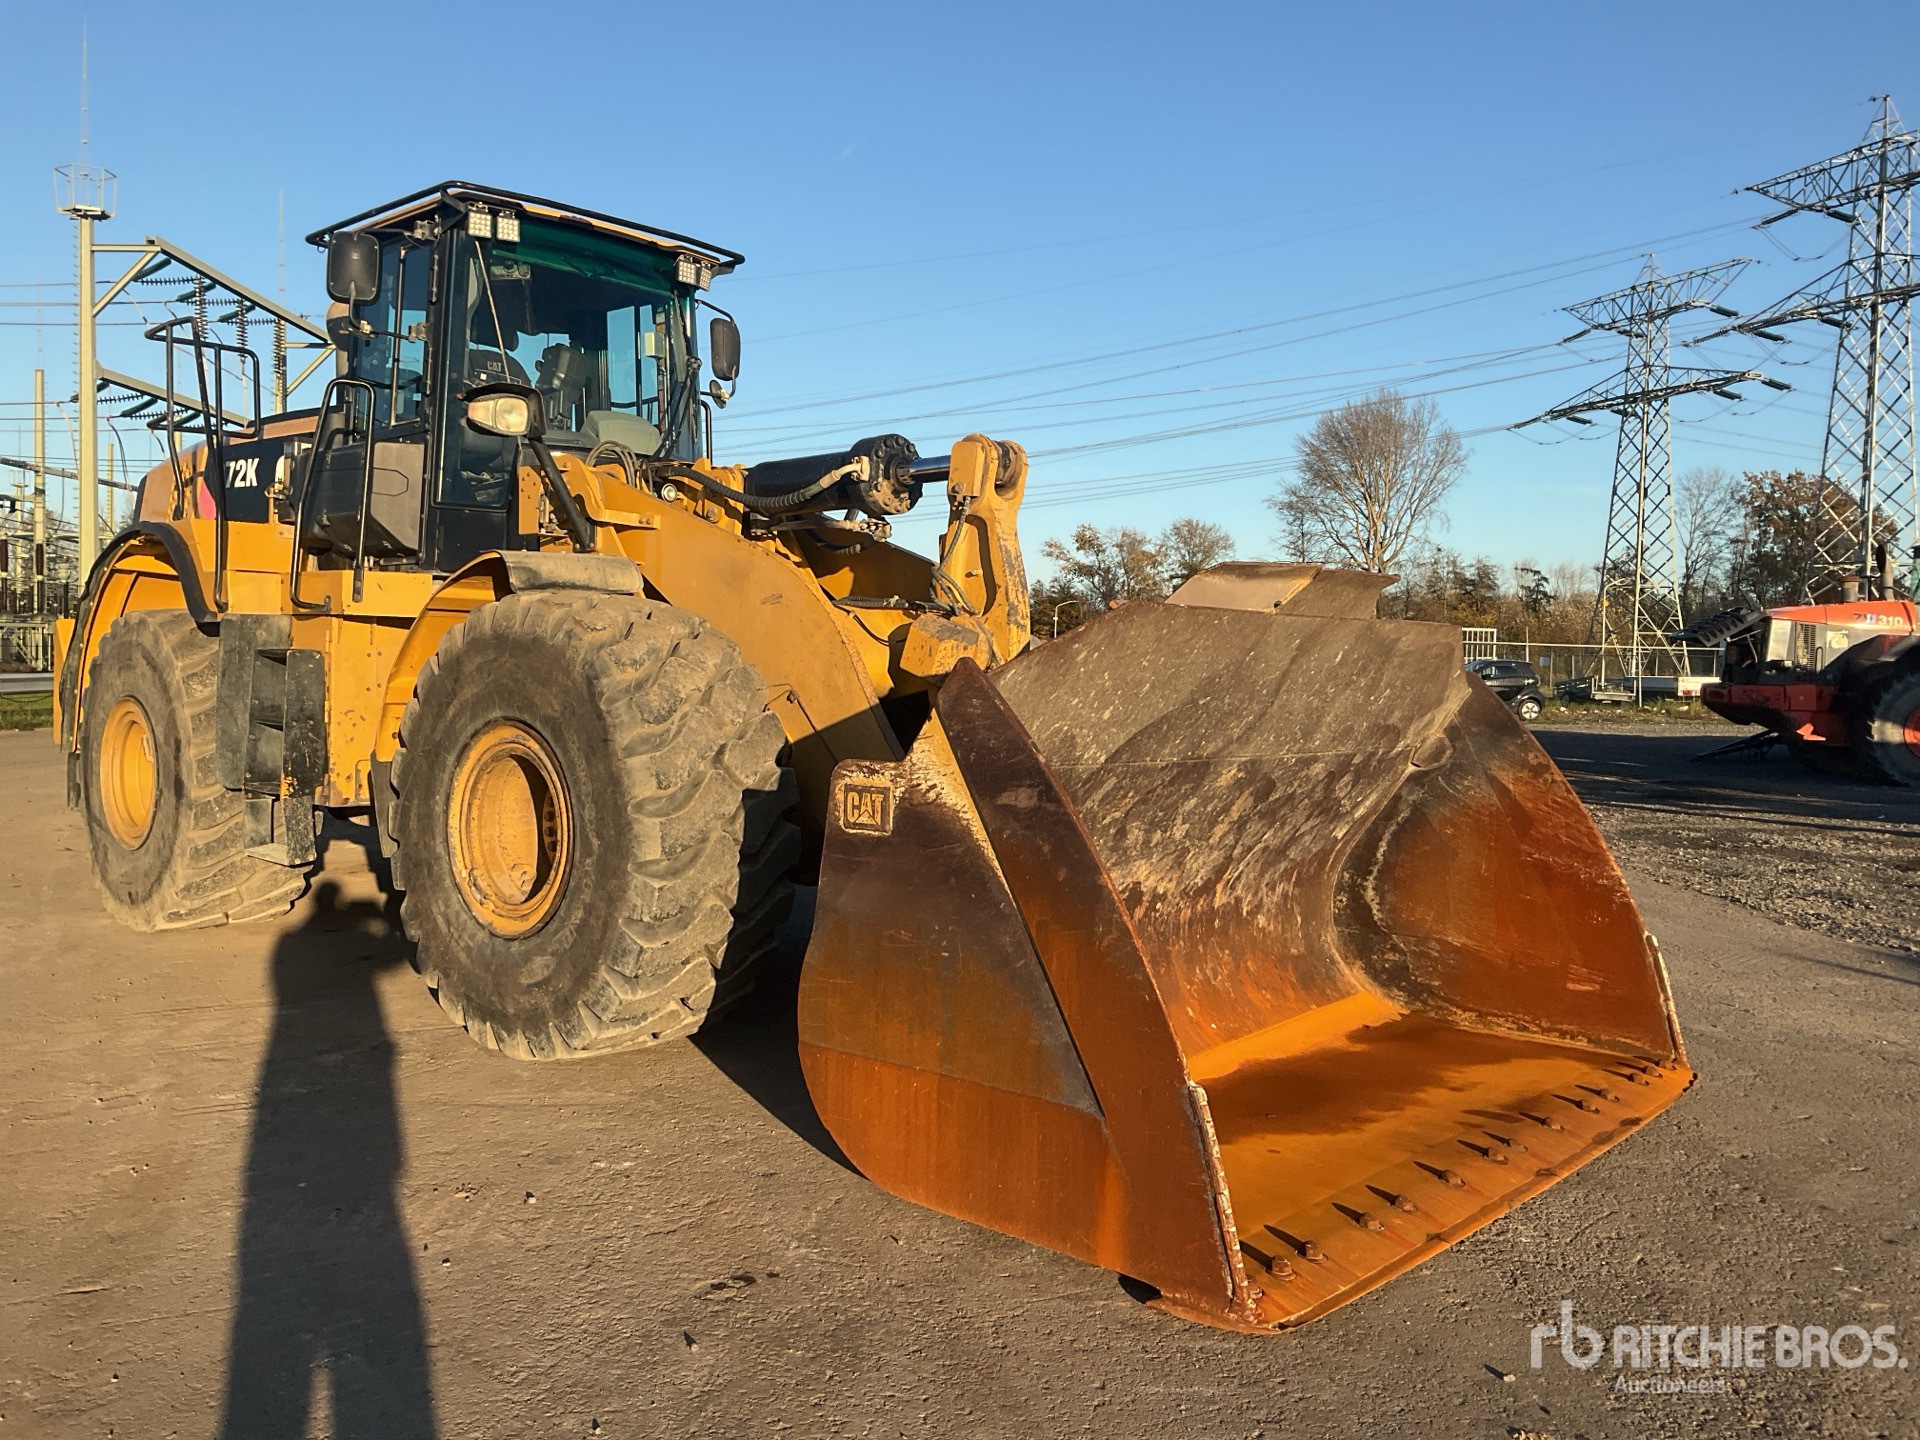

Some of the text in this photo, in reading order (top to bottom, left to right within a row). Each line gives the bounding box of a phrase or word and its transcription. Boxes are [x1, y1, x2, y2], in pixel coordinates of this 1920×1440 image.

[487, 361, 502, 372] CAT
[1878, 614, 1904, 626] 310
[847, 791, 884, 825] CAT
